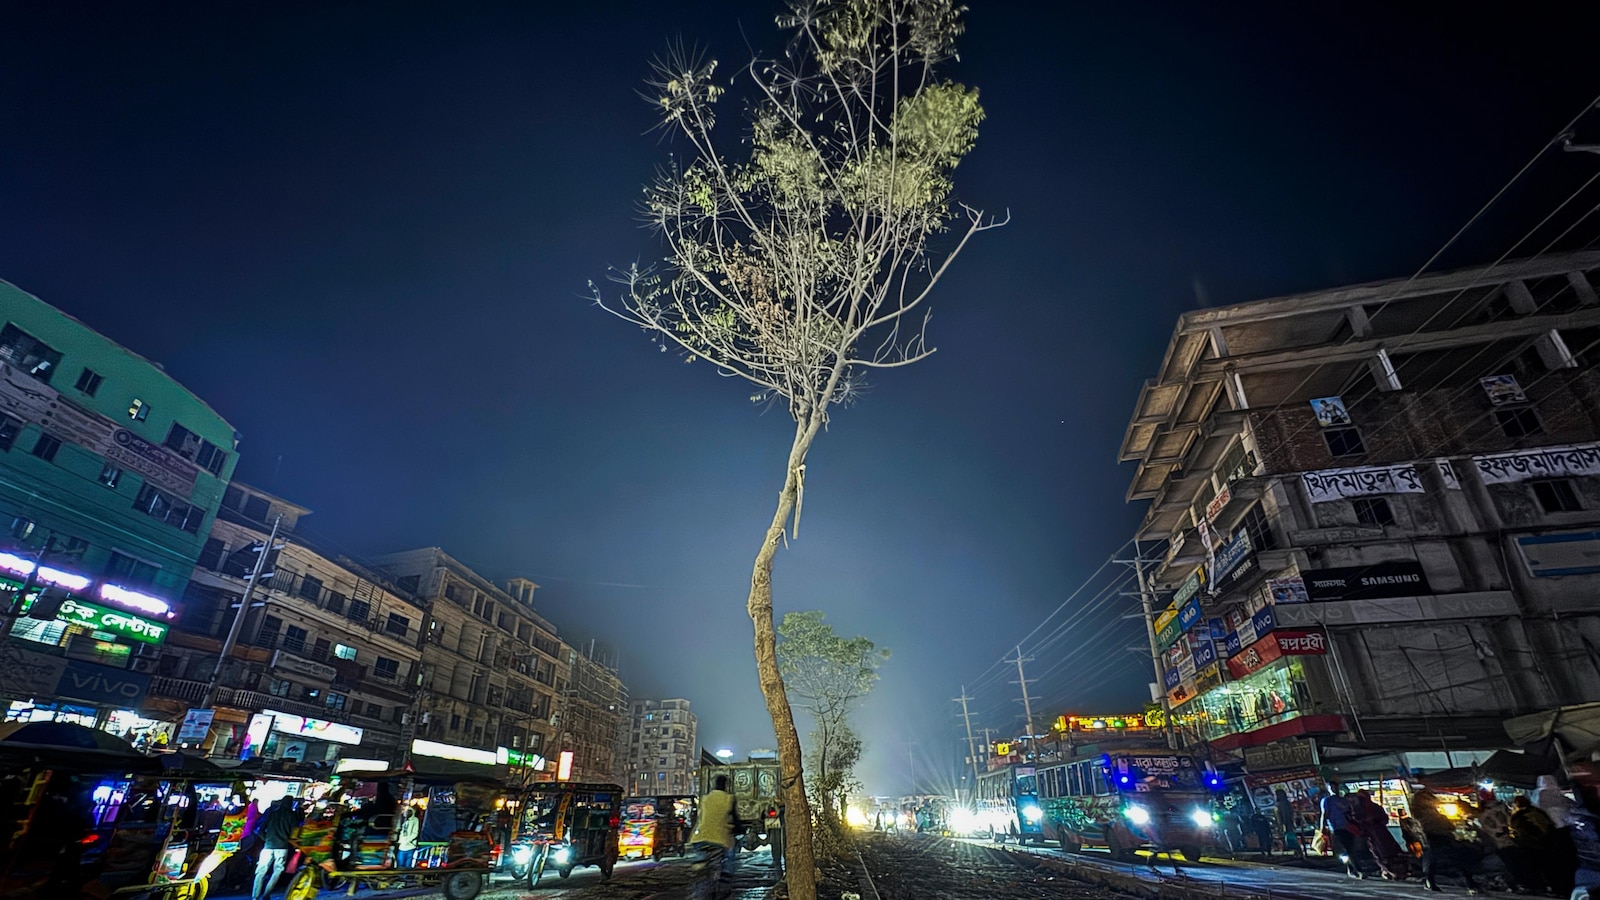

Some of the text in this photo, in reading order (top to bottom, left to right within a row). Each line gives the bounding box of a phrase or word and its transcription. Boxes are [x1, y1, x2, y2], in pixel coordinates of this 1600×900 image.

[1231, 559, 1253, 582] SAMSUNG
[1360, 573, 1420, 587] SAMSUNG
[1181, 606, 1197, 624] vivo
[1255, 614, 1272, 631] vivo
[101, 612, 165, 639] সেন্টার
[1226, 637, 1240, 652] vivo
[1195, 648, 1211, 665] vivo
